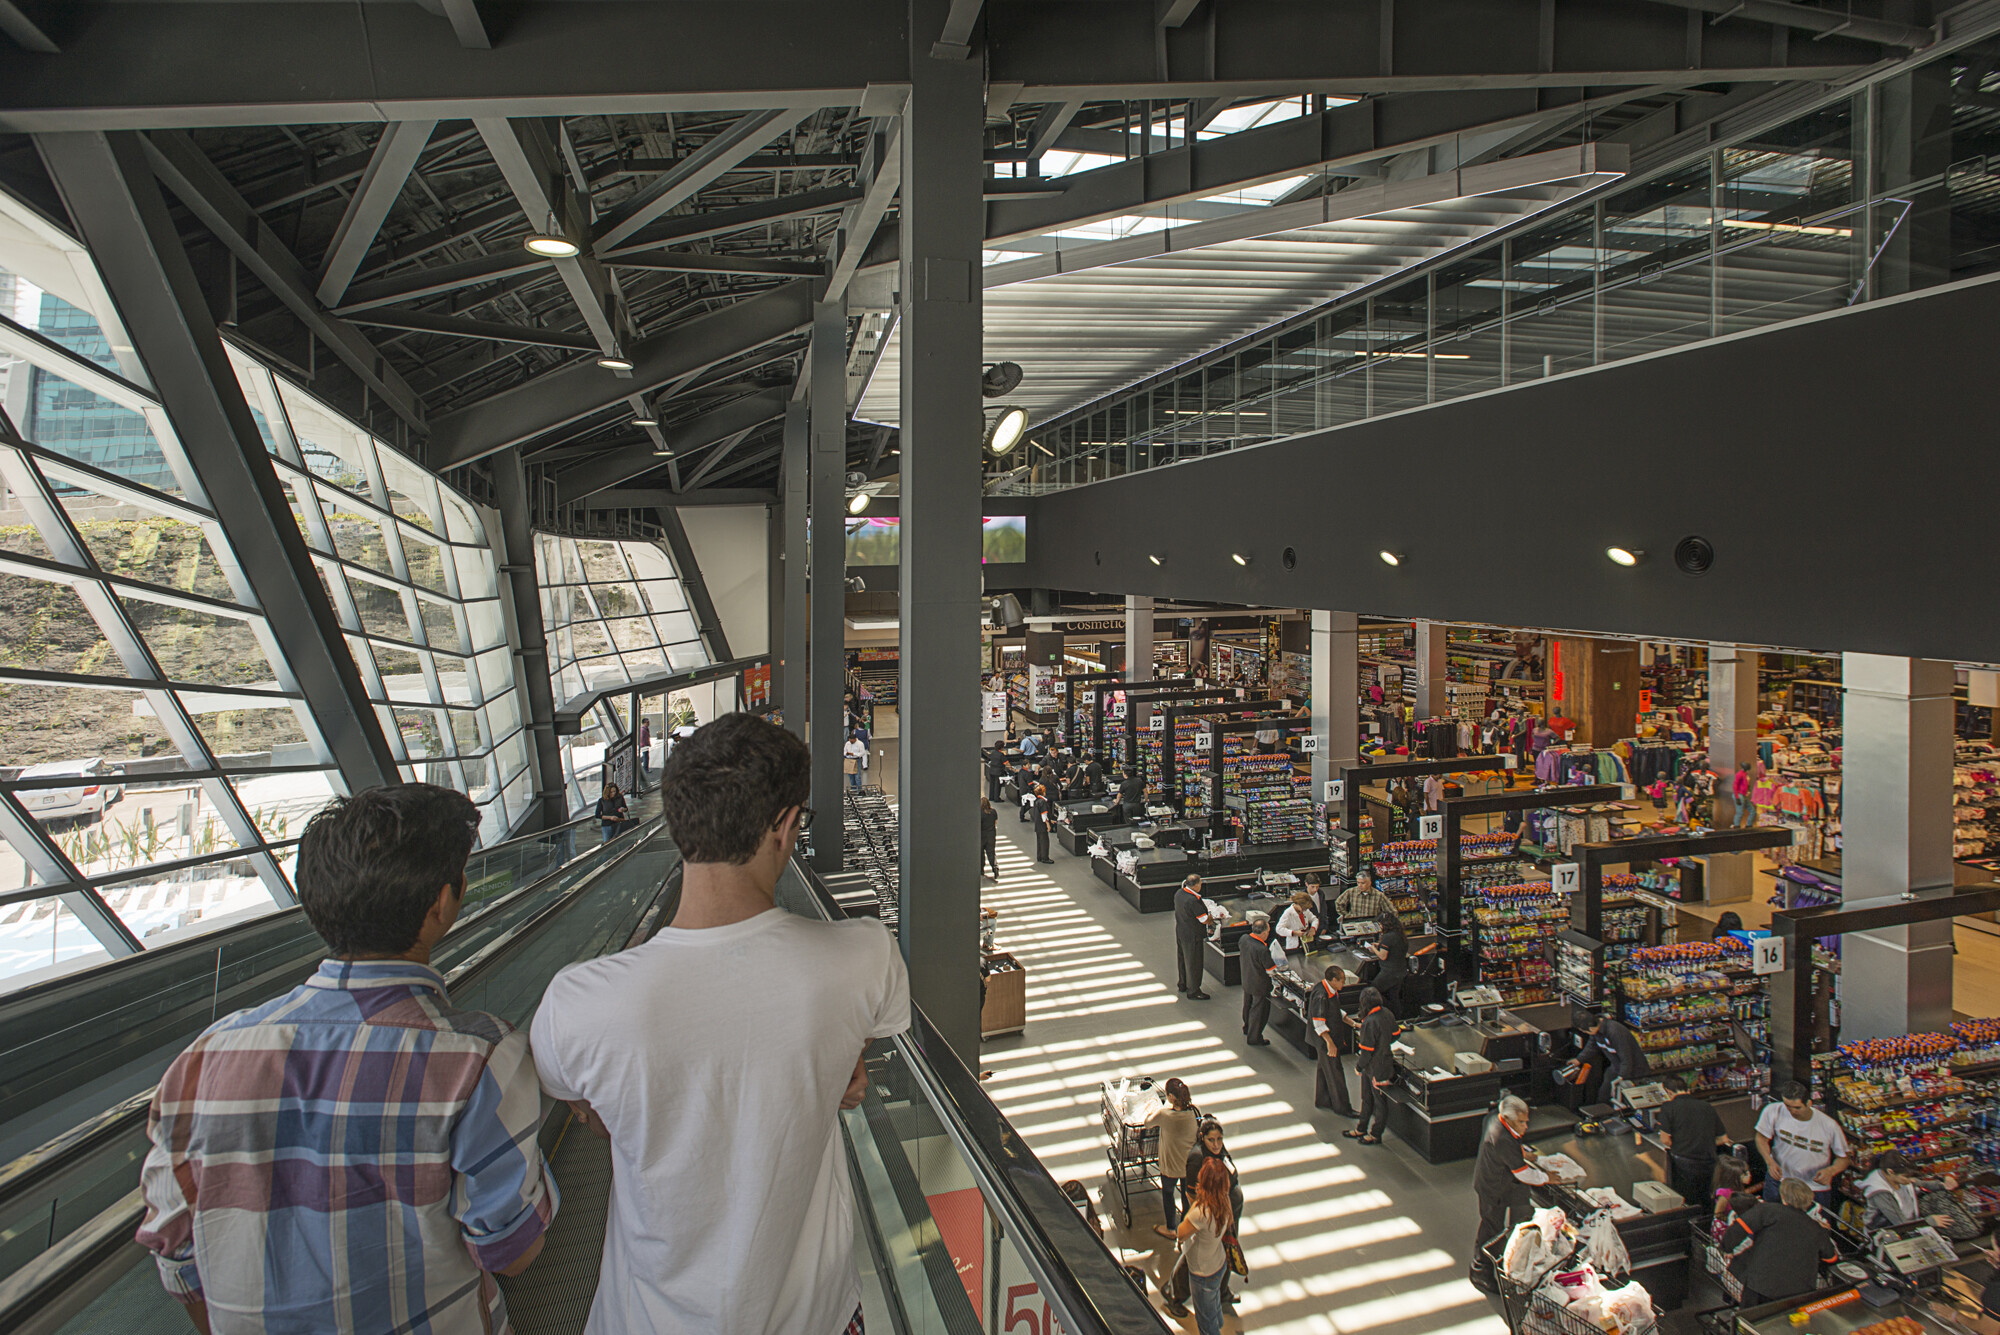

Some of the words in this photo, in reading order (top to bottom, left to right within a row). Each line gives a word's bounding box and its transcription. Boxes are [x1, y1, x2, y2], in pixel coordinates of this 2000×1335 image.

[1115, 705, 1125, 713] 23
[1152, 719, 1162, 727] 22
[1199, 737, 1209, 746] 21
[1304, 739, 1316, 748] 20
[1329, 785, 1340, 796] 19
[1425, 821, 1438, 834] 18
[1560, 871, 1575, 885] 17
[1762, 946, 1778, 964] 16
